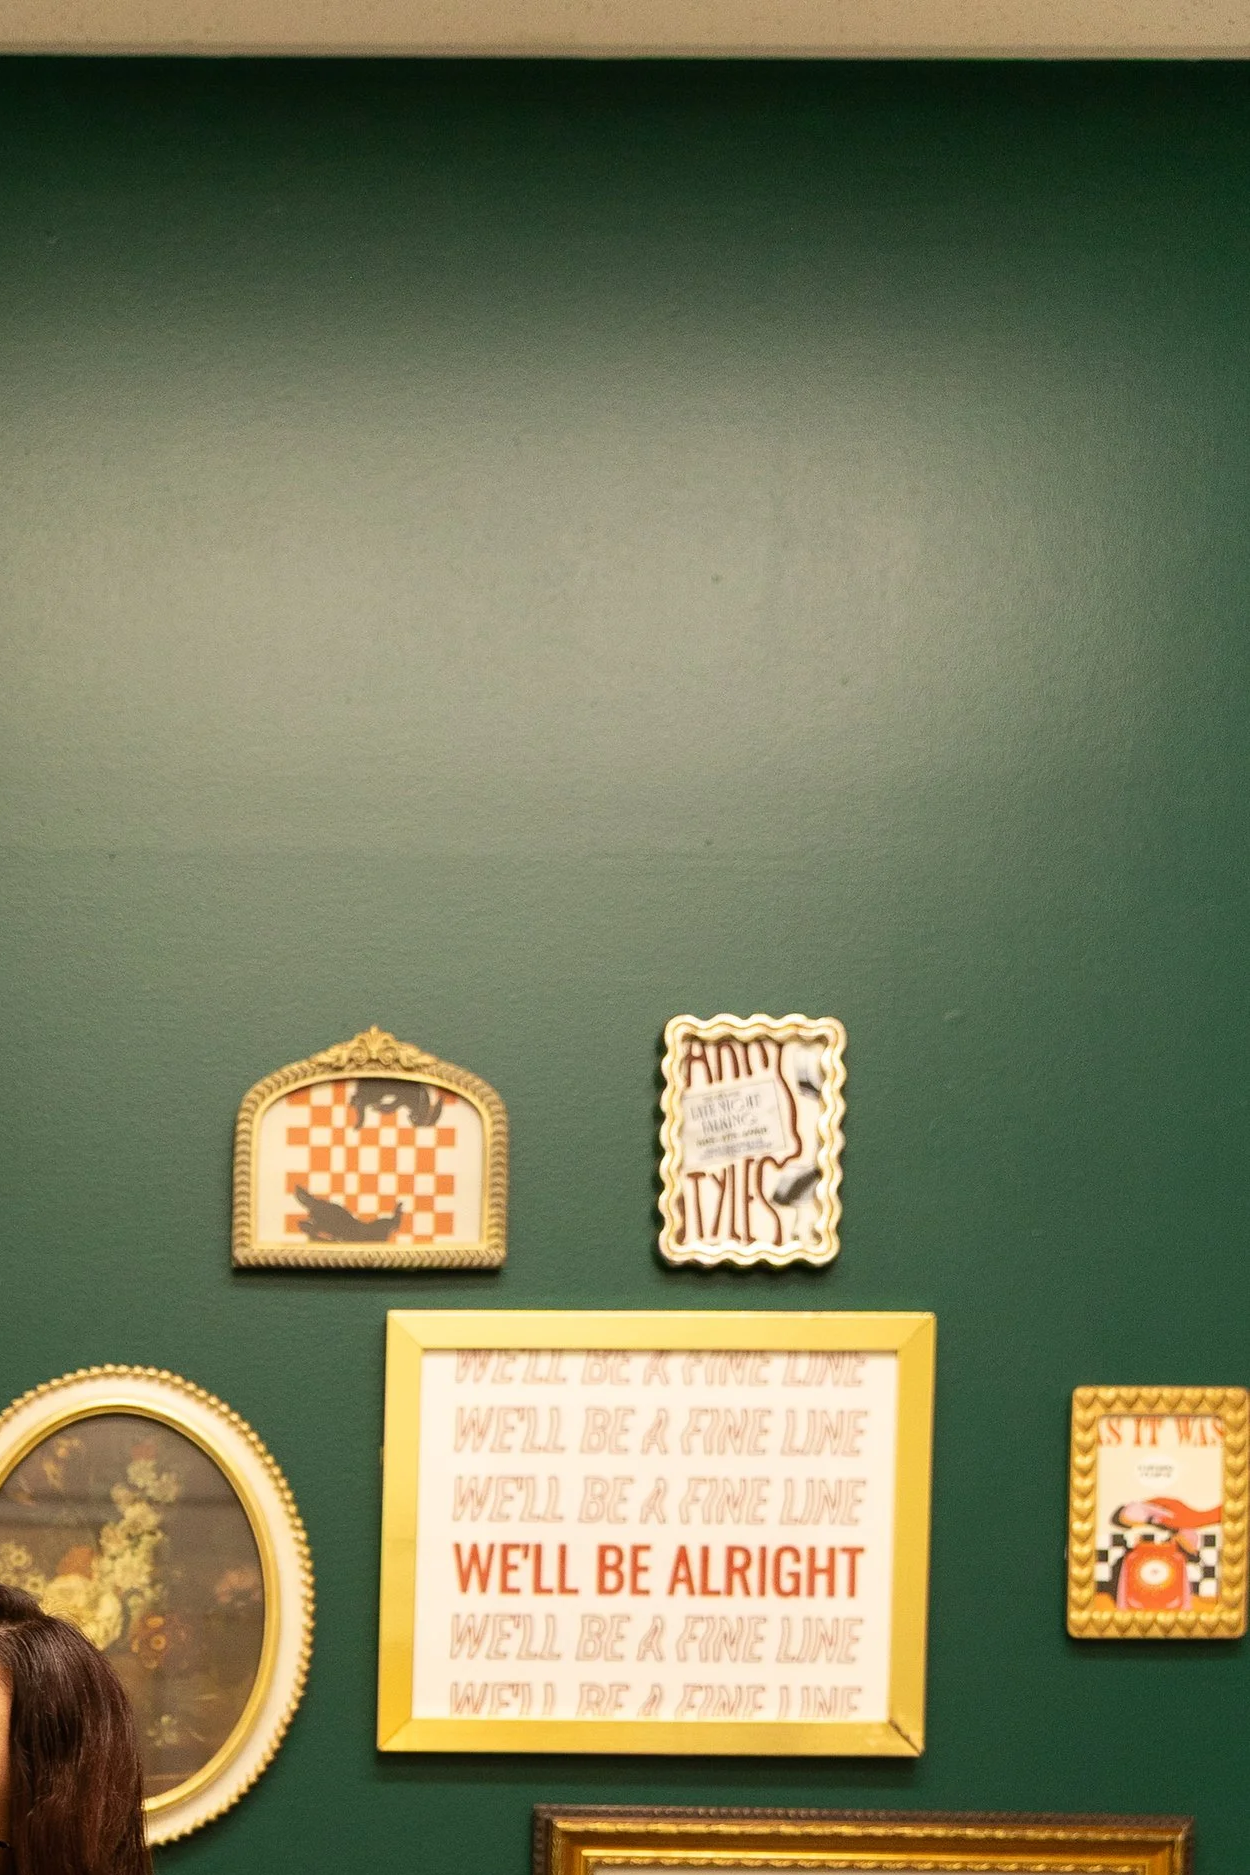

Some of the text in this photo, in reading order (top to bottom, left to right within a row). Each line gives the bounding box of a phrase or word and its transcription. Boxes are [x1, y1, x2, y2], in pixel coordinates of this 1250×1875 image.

[452, 1407, 869, 1457] WE'LL BE A FINE LINE
[451, 1475, 868, 1526] WE'LL BE A FINE LINE
[452, 1542, 865, 1598] WE'LL BE ALRIGHT
[450, 1612, 864, 1664] WE'LL BE A FINE LINE
